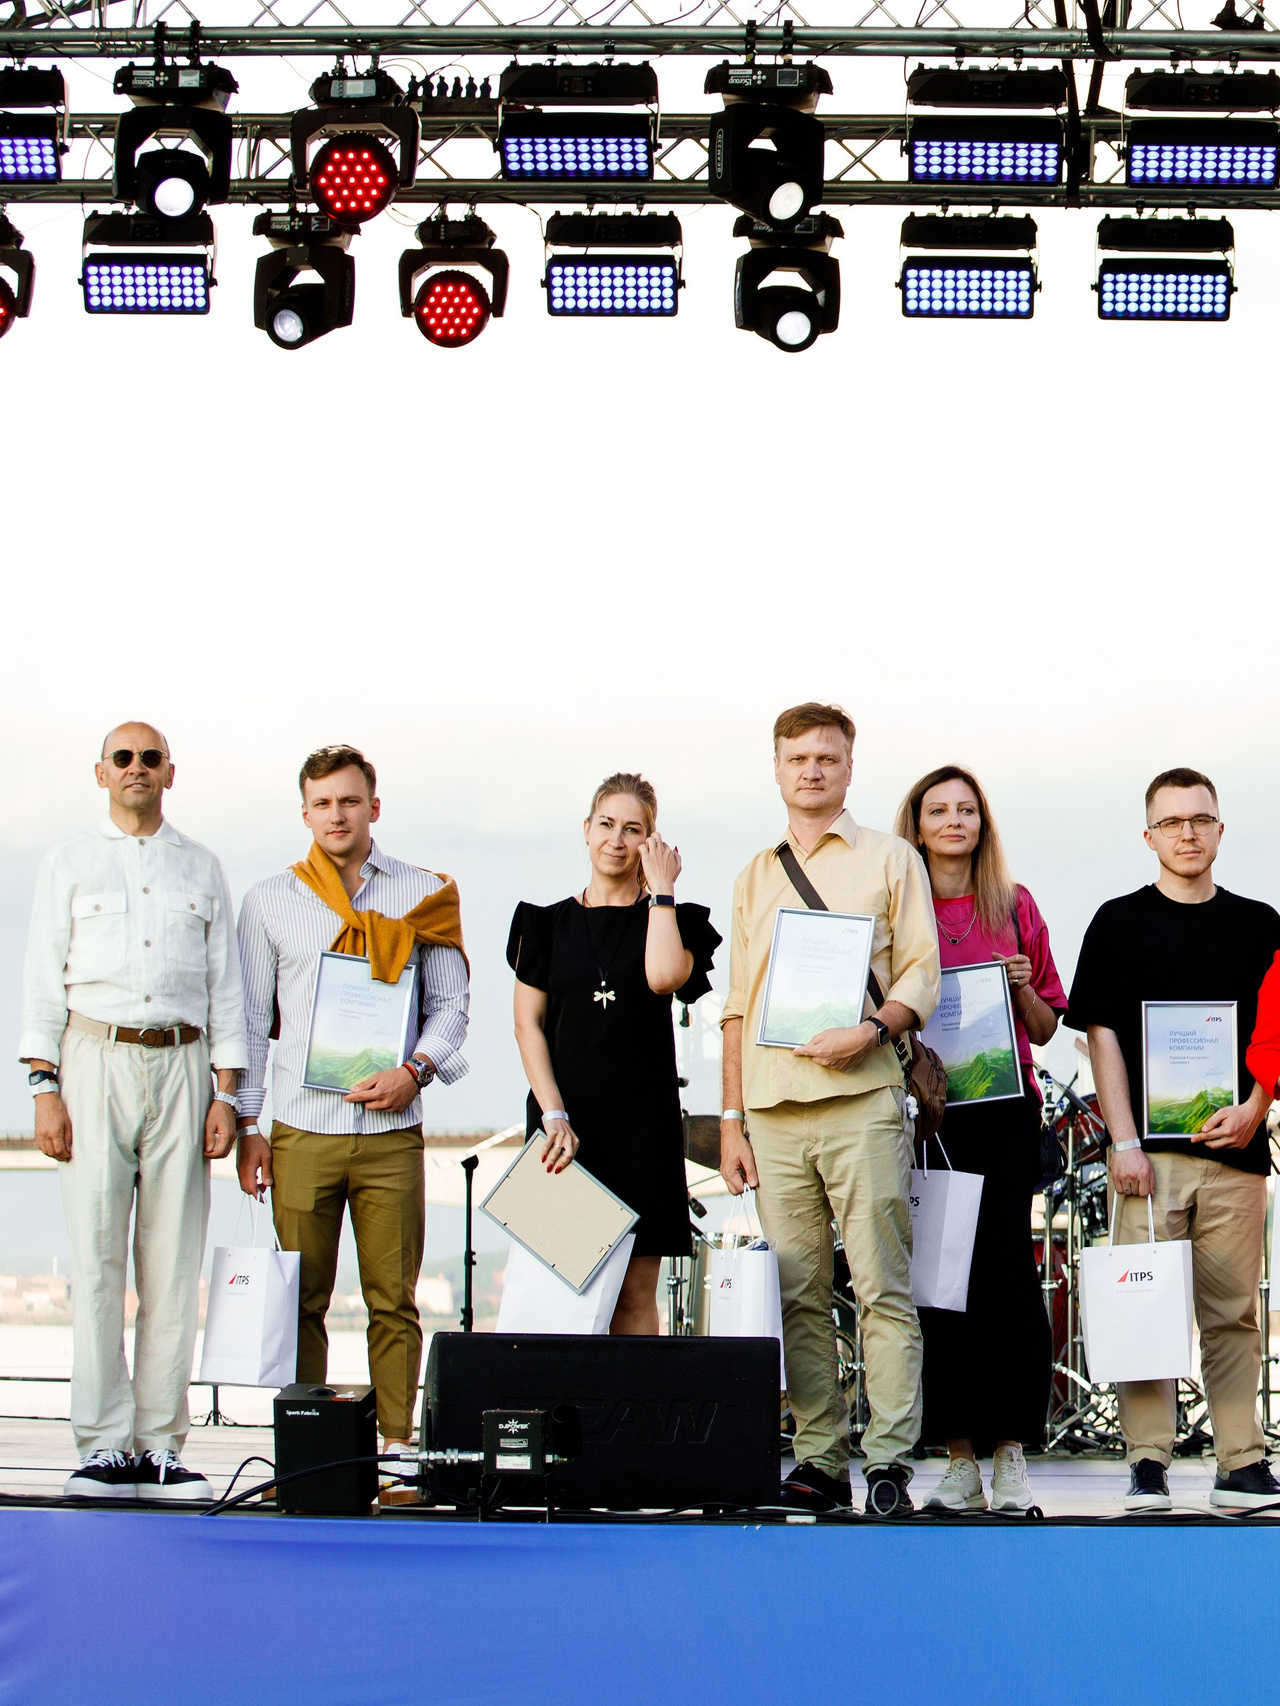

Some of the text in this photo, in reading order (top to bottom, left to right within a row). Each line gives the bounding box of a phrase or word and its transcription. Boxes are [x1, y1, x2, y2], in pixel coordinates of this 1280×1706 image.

[342, 983, 370, 993] ЛУЧШИЙ
[341, 990, 392, 1004] ПРОФЕССИОНАЛ
[340, 998, 376, 1008] КОМПАНИИ
[236, 1275, 250, 1285] ITPS
[1130, 1271, 1154, 1282] ITPS
